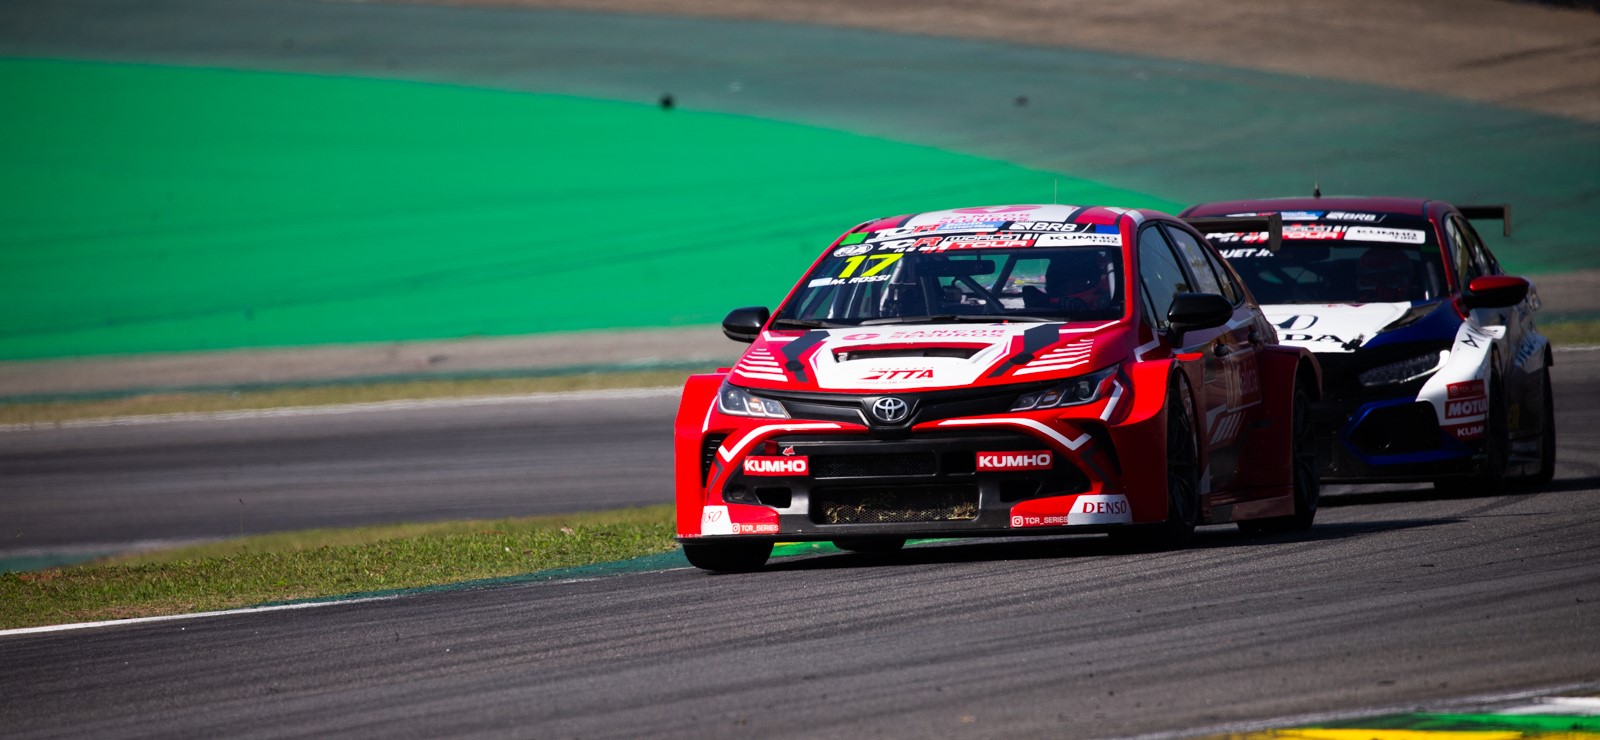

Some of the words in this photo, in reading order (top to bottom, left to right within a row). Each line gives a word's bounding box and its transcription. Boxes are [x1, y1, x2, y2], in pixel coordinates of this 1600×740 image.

[1343, 213, 1377, 221] BRB
[874, 224, 942, 239] TCR
[1032, 222, 1078, 232] BRB
[878, 236, 943, 250] TCR
[838, 253, 904, 278] 17
[848, 274, 892, 284] ROSSI
[1447, 399, 1488, 416] MOTU
[744, 460, 807, 472] KUMHO
[979, 454, 1051, 467] KUMHO
[1083, 500, 1127, 514] DENSO
[1024, 516, 1068, 525] TCR_SERIES
[741, 524, 779, 533] TCR_SERIES
